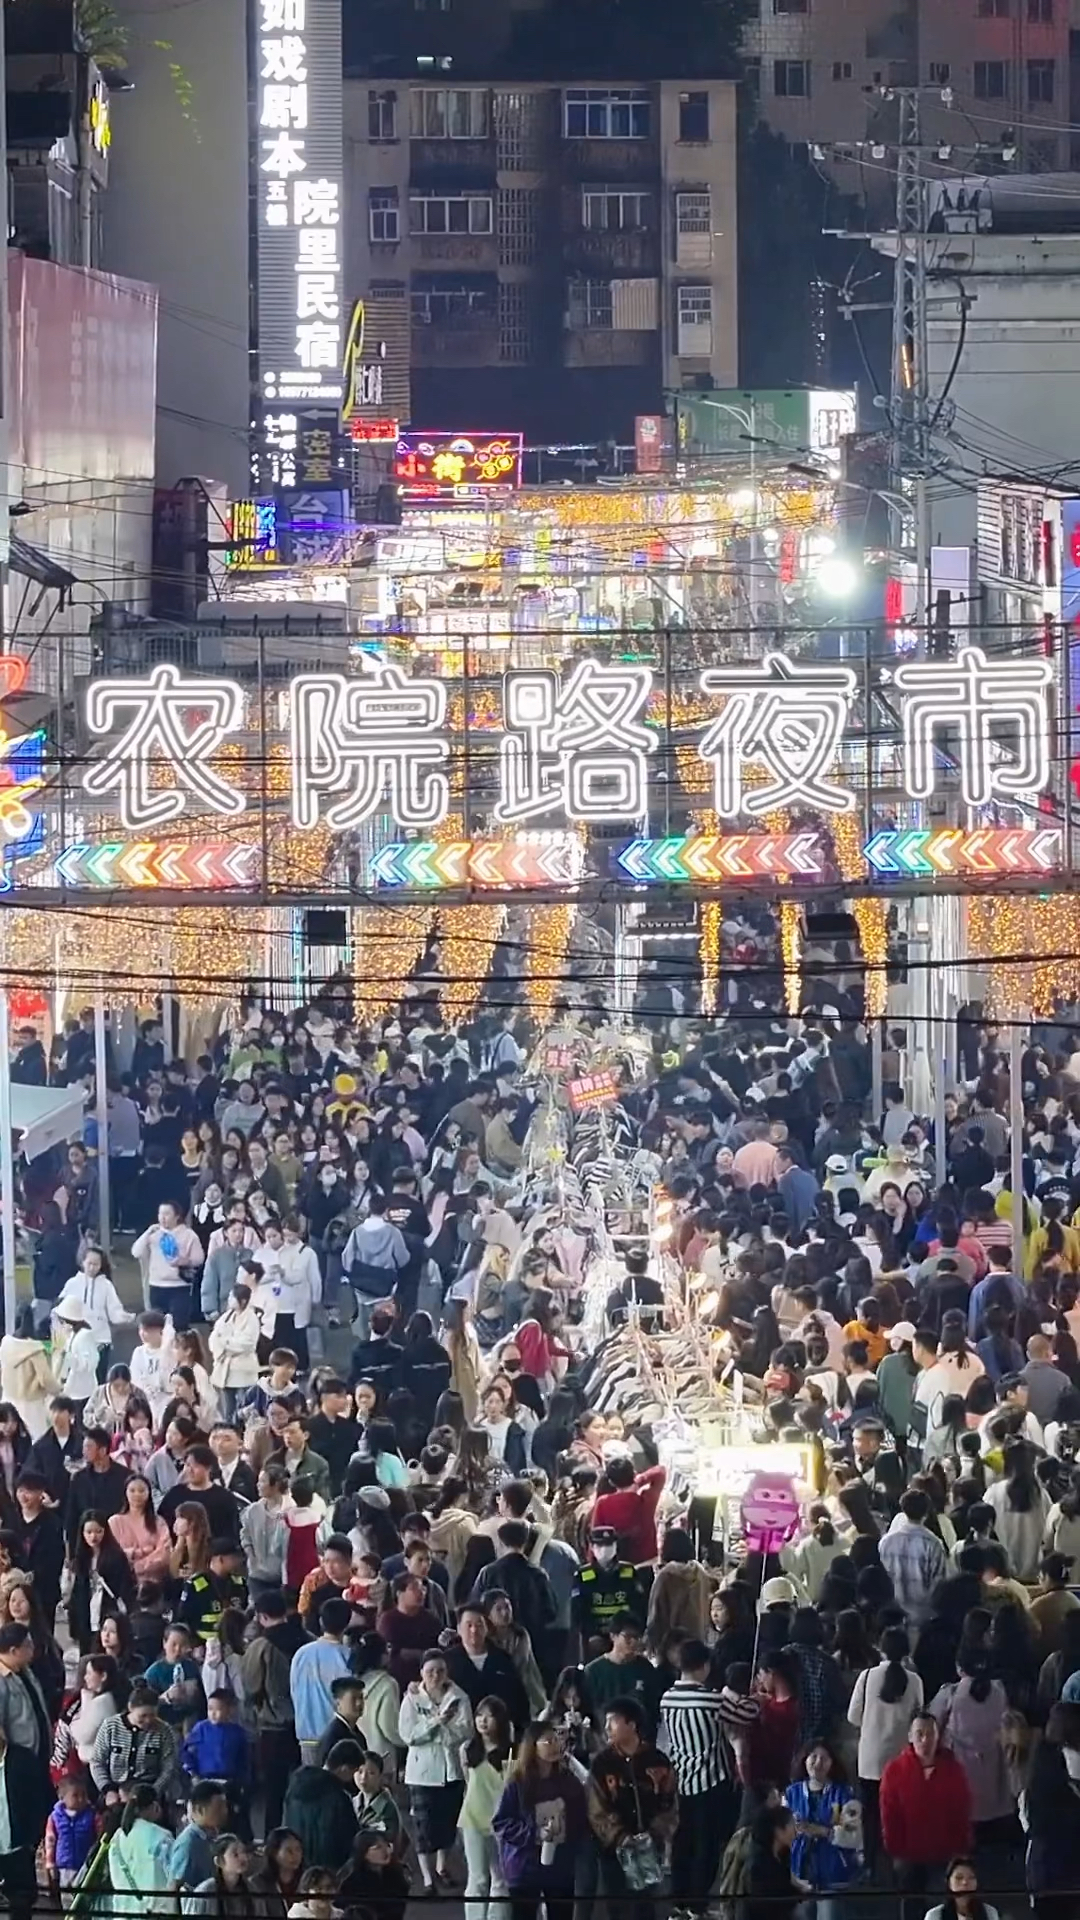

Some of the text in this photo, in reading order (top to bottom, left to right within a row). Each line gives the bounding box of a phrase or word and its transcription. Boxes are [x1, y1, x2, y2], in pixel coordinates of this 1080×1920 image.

[294, 179, 340, 367] 院里民宿
[83, 647, 1053, 830] 农院路夜市
